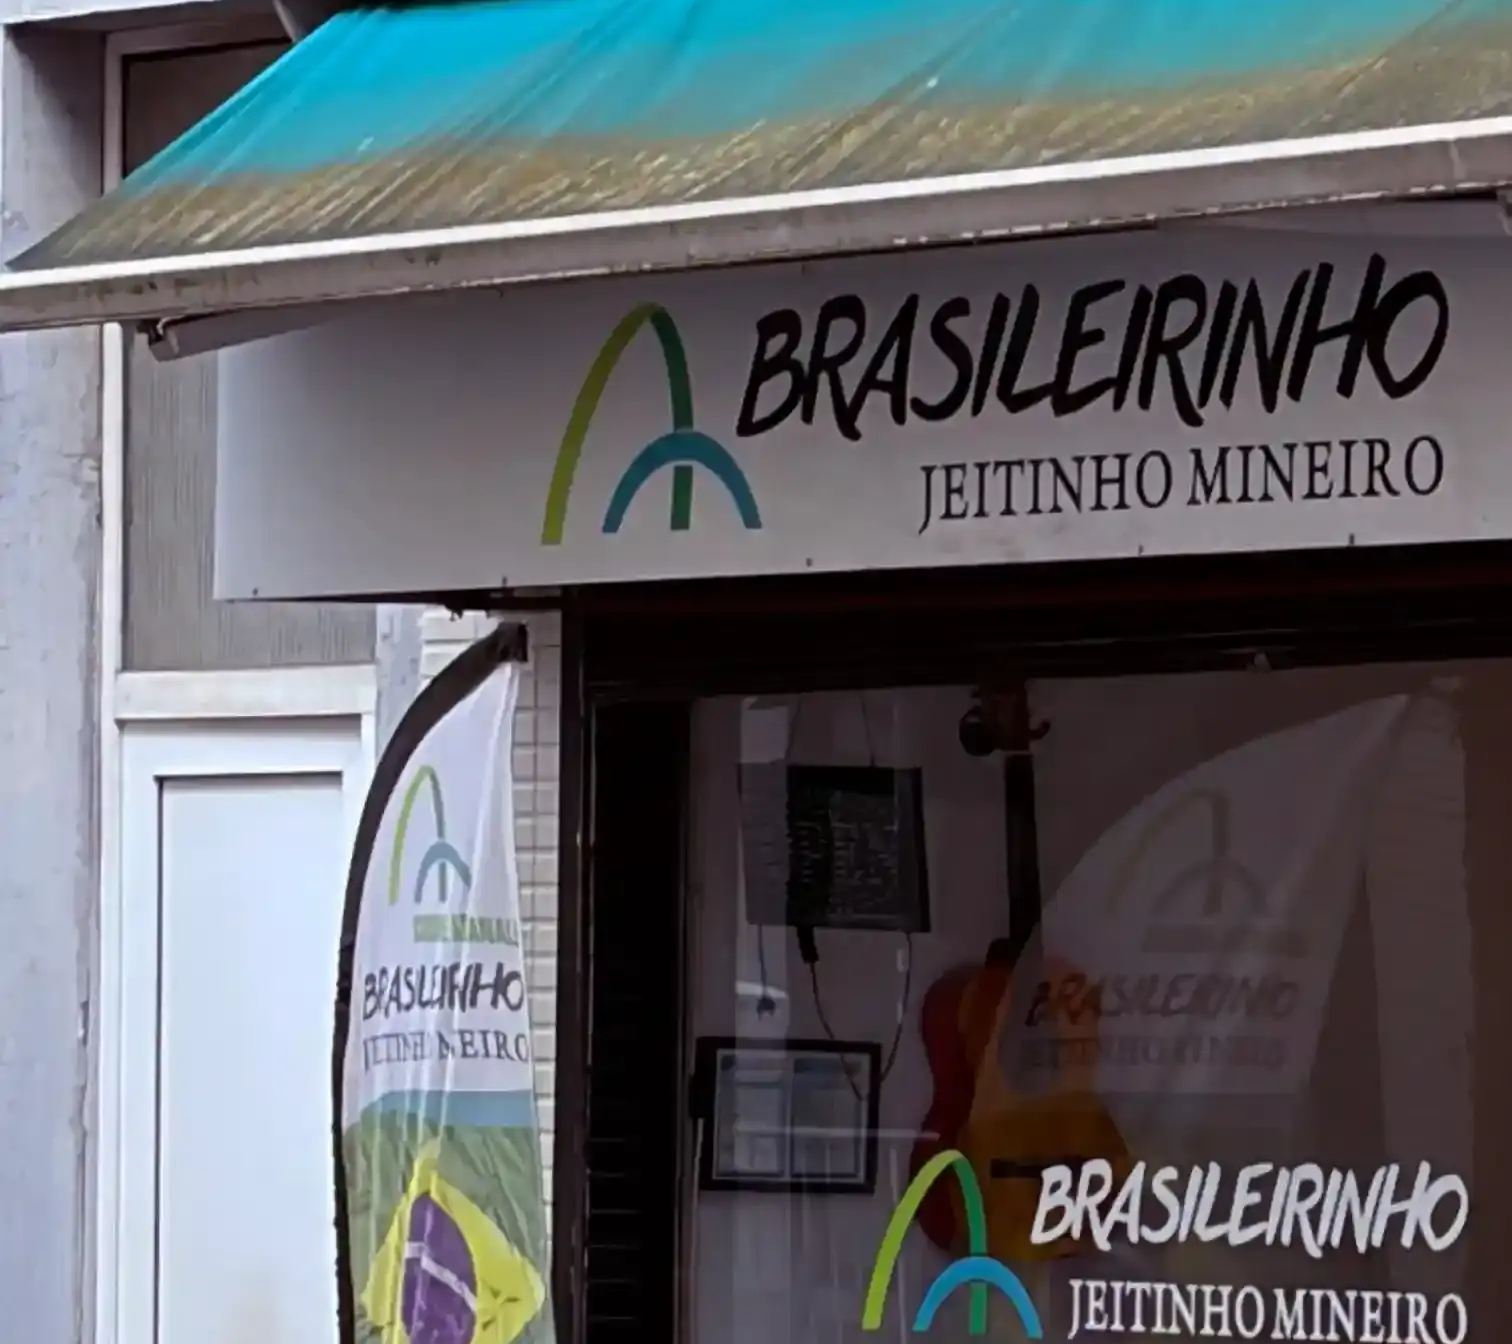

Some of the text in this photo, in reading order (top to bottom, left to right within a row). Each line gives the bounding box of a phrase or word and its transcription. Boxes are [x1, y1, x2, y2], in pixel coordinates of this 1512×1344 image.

[736, 253, 1450, 441] BRASILEIRINHO
[918, 435, 1444, 534] JEITINHO MINEIRO
[1030, 1158, 1470, 1258] BRASILEIRINHO
[1068, 1279, 1265, 1340] JEITINHO
